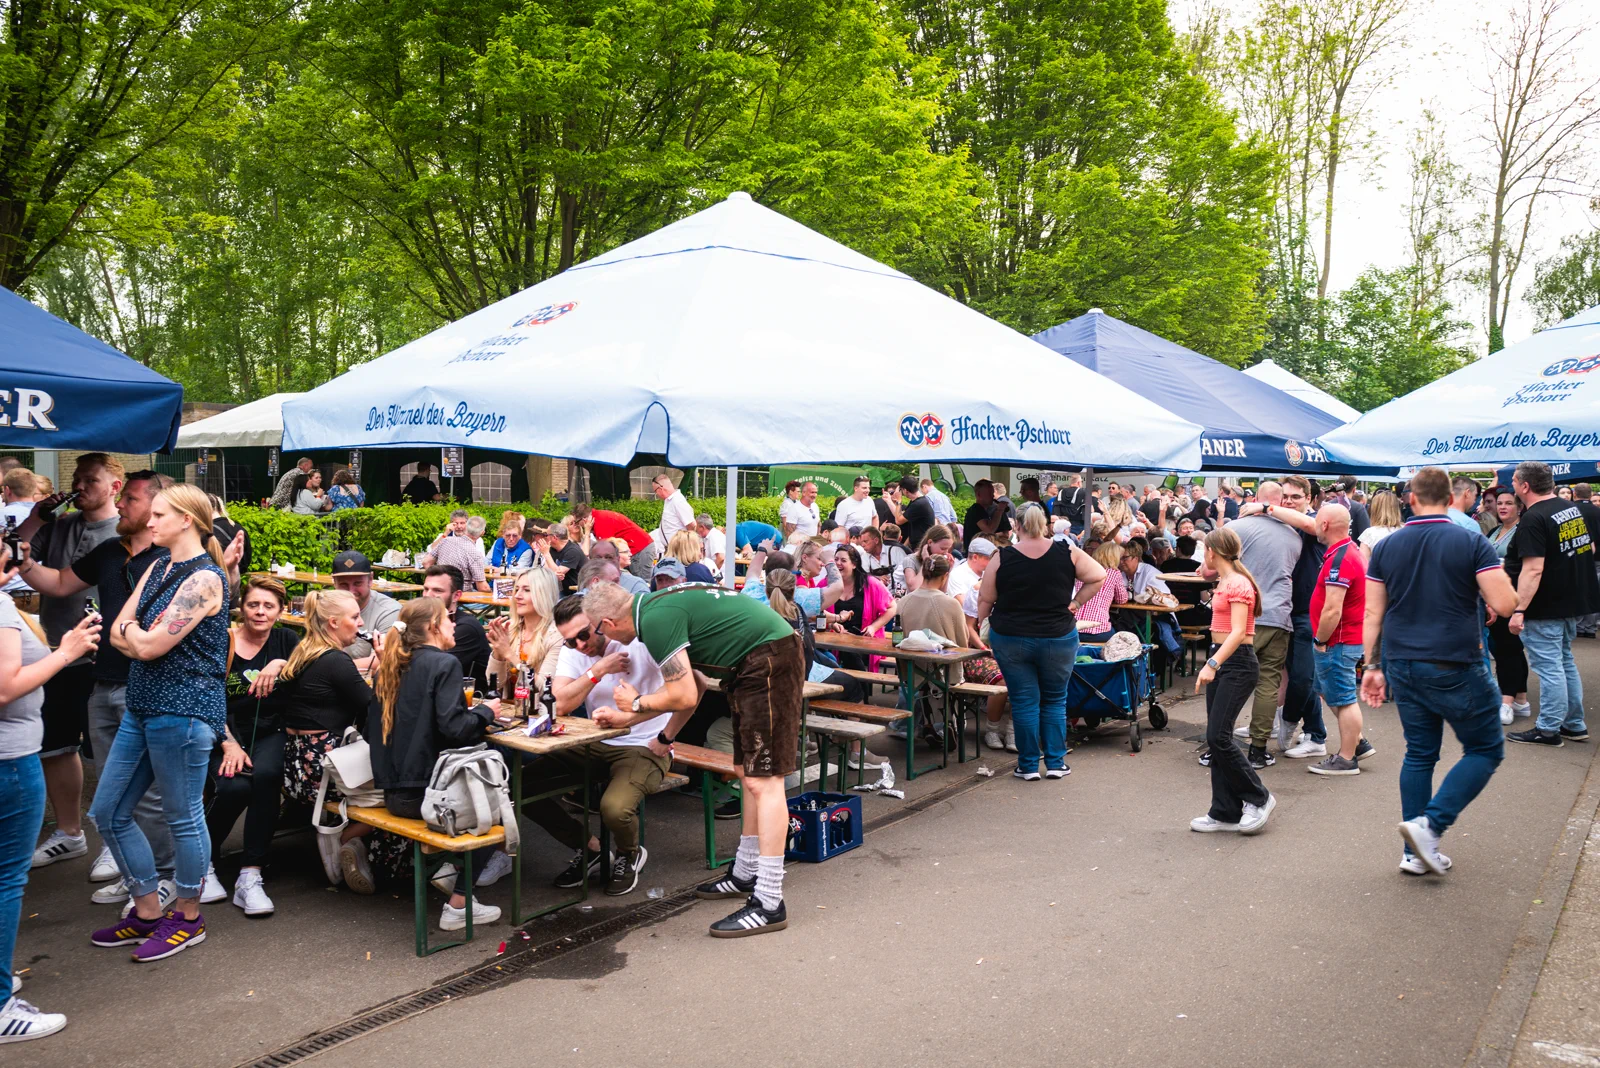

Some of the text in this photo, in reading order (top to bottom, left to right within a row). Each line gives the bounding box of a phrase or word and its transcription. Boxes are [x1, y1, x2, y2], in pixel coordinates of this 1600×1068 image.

[1516, 380, 1585, 395] Hacker
[0, 387, 59, 431] R
[1501, 392, 1571, 408] Pschorr
[366, 407, 385, 431] Der
[427, 402, 445, 426] der
[447, 401, 507, 437] Bayern
[951, 415, 1071, 450] Hacker-Pschorr
[1422, 427, 1600, 456] Der Himmel der Bayer
[1201, 438, 1247, 457] ANER
[1552, 463, 1571, 476] NER
[815, 476, 829, 484] und
[830, 480, 849, 498] Zube
